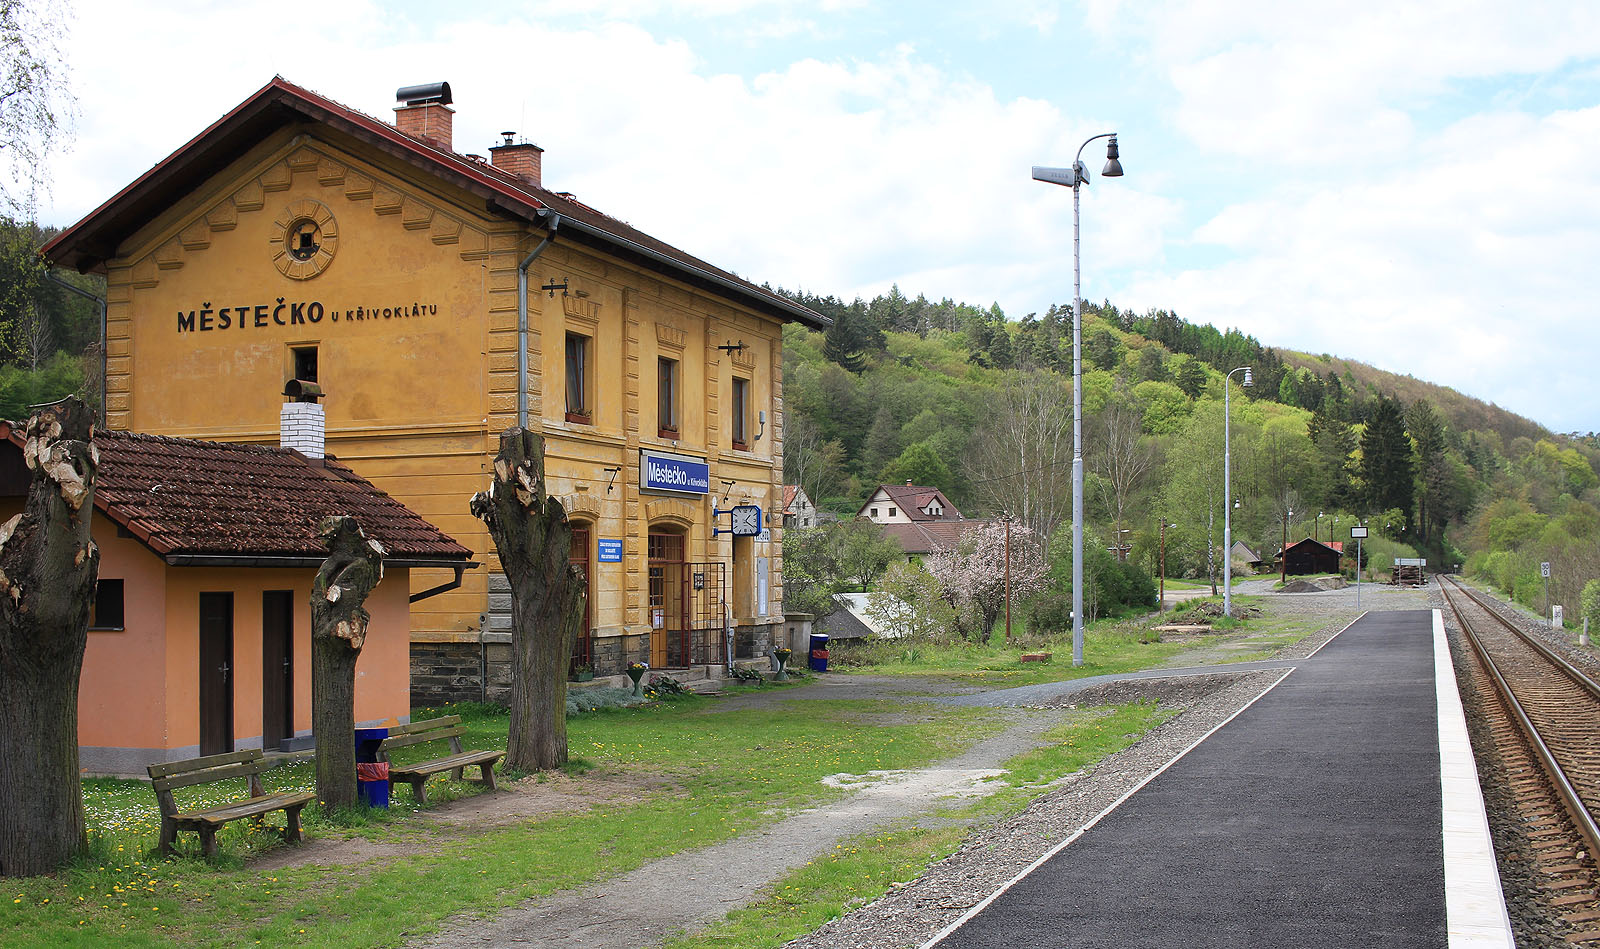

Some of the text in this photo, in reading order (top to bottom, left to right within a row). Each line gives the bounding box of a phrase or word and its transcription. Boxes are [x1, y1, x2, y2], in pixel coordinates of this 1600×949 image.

[176, 296, 438, 333] MĚSTEČKO U KŘIVOKLÁTU
[648, 462, 686, 486] Městečko
